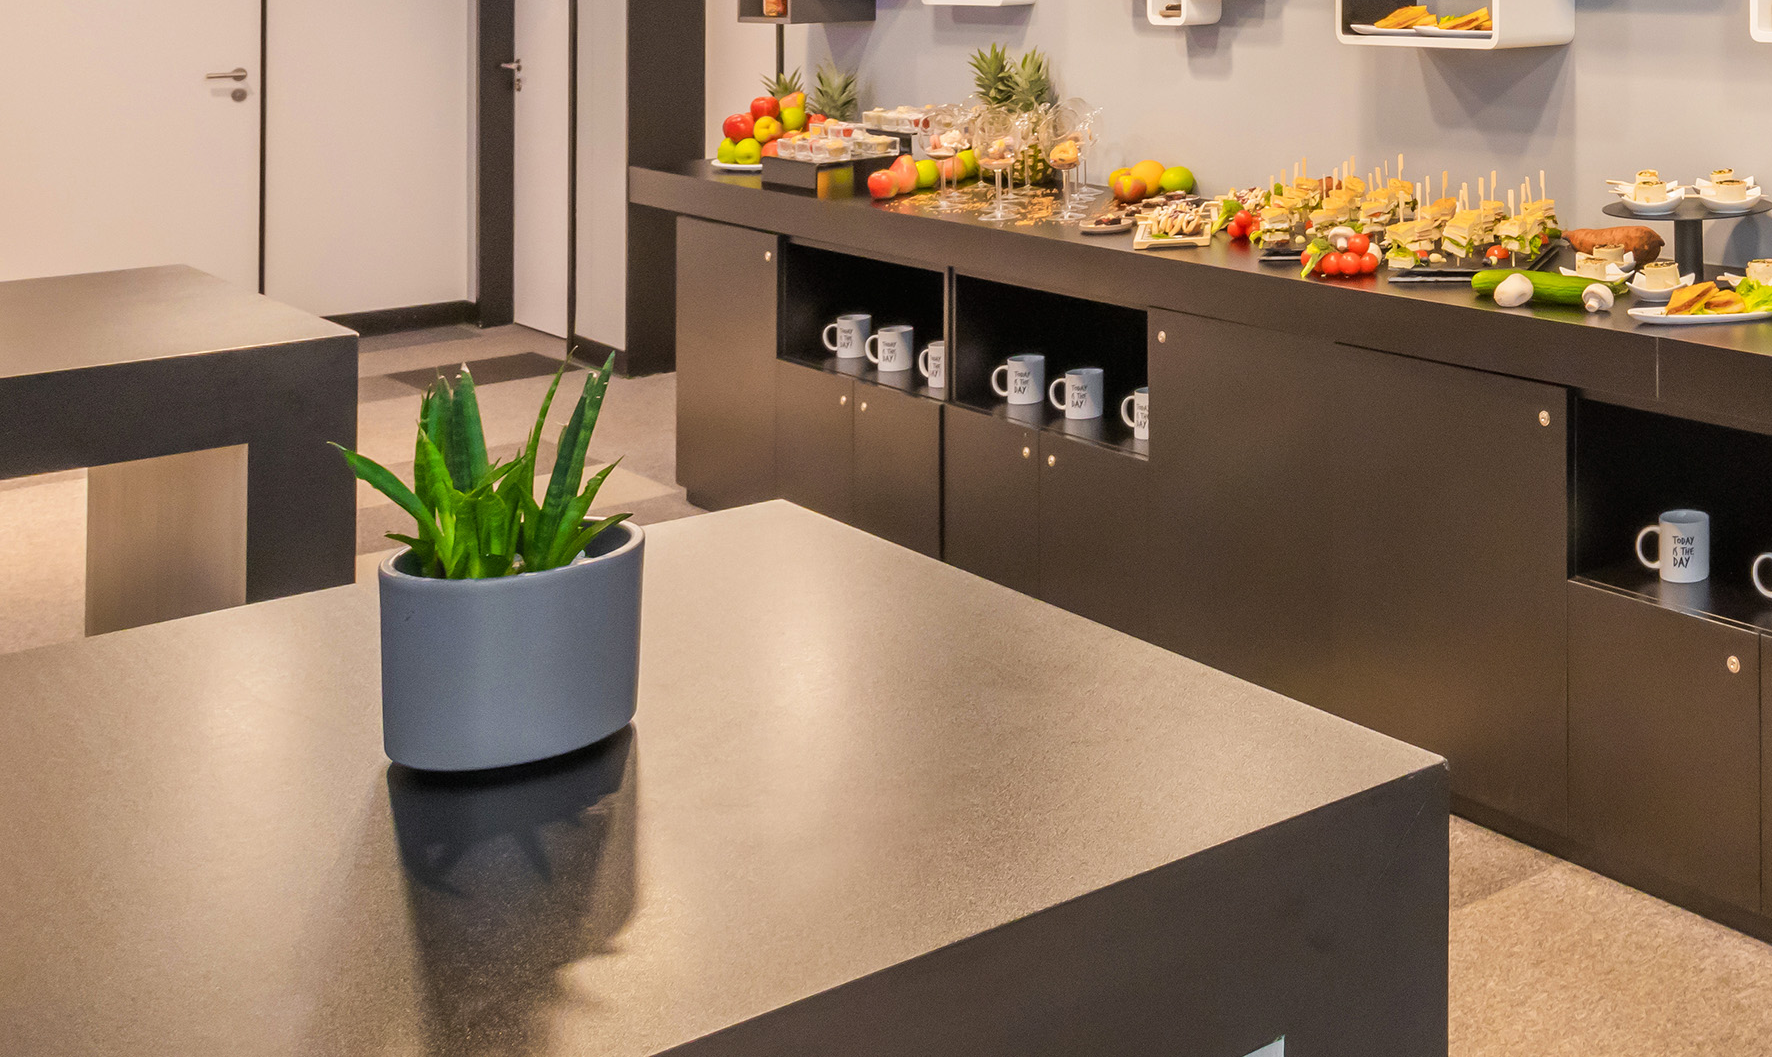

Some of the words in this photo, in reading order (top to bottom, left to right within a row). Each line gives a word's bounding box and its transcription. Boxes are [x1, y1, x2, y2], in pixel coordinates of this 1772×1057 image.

[1672, 536, 1695, 545] TODAY
[1680, 546, 1694, 556] THE
[1673, 556, 1690, 568] DAY
